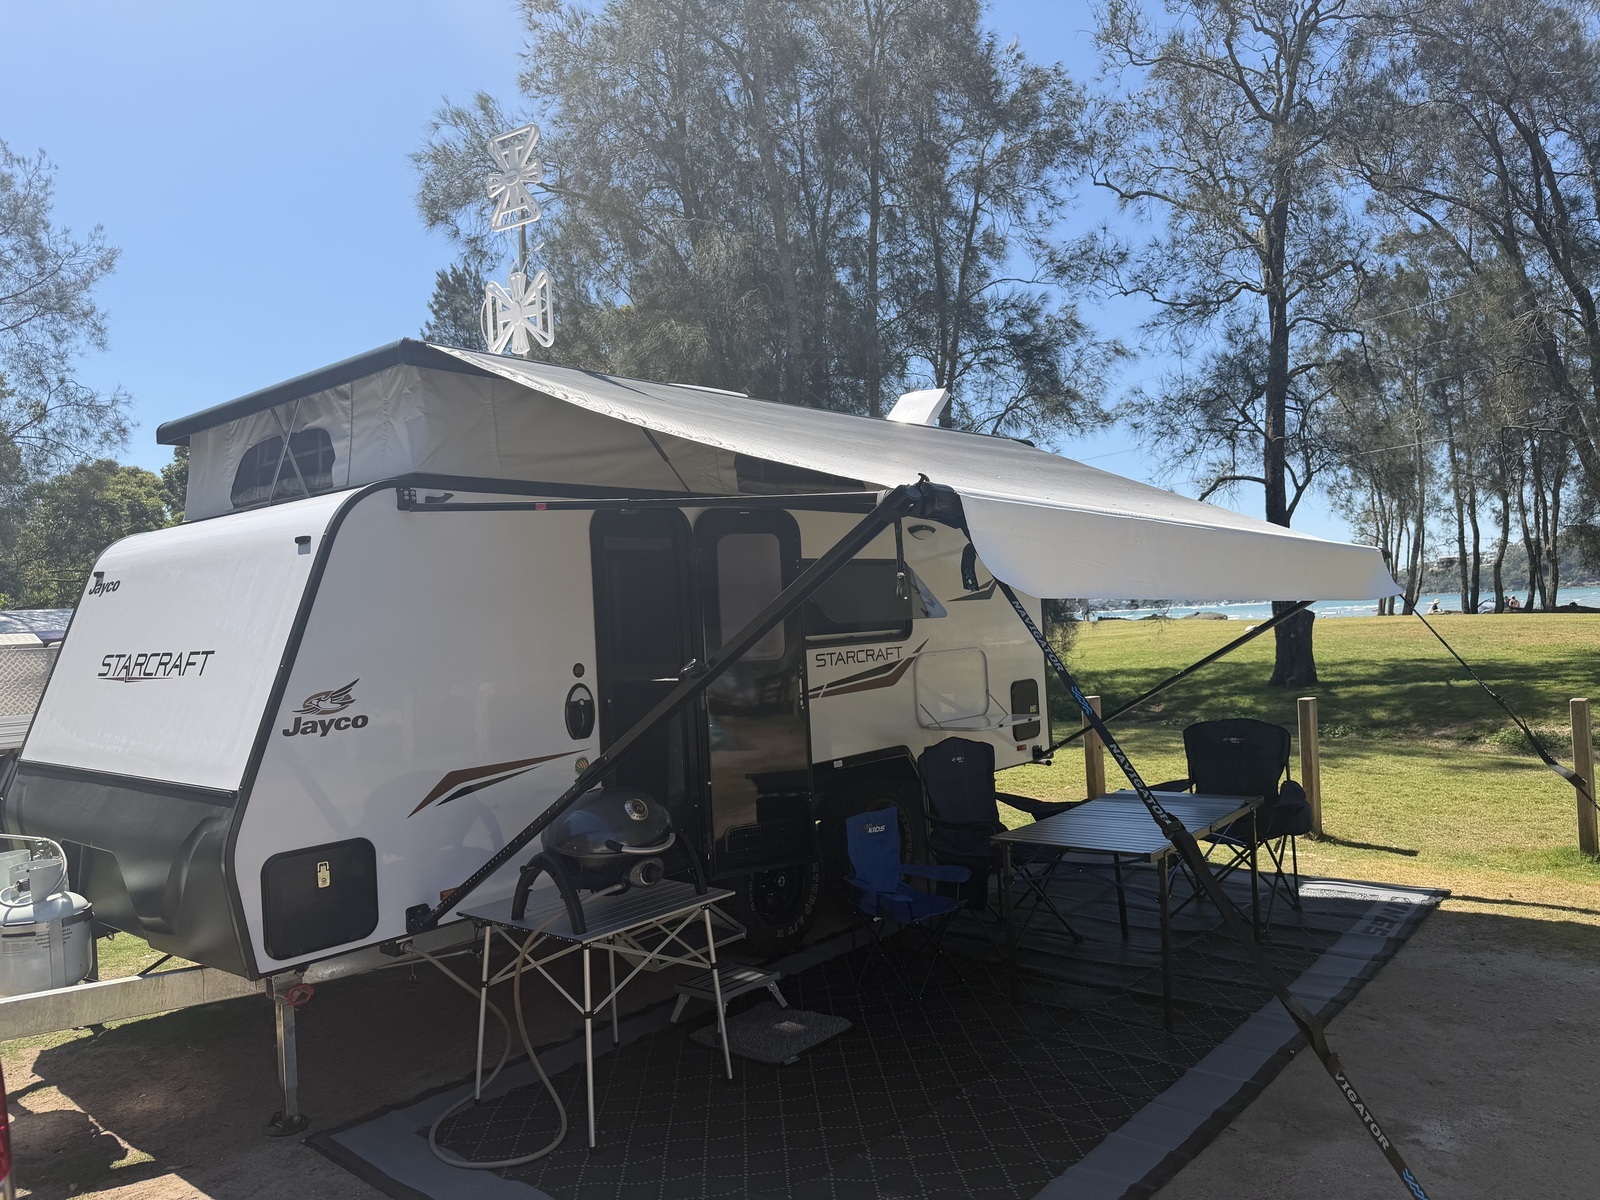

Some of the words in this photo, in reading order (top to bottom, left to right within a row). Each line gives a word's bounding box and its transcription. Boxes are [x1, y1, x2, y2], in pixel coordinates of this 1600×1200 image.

[88, 578, 121, 598] Jayco
[1012, 600, 1064, 672] NAVIGATOR
[97, 650, 216, 677] STARCRAFT
[815, 646, 903, 668] STARCRAFT
[282, 713, 369, 737] Jayco
[868, 824, 886, 834] KIDS
